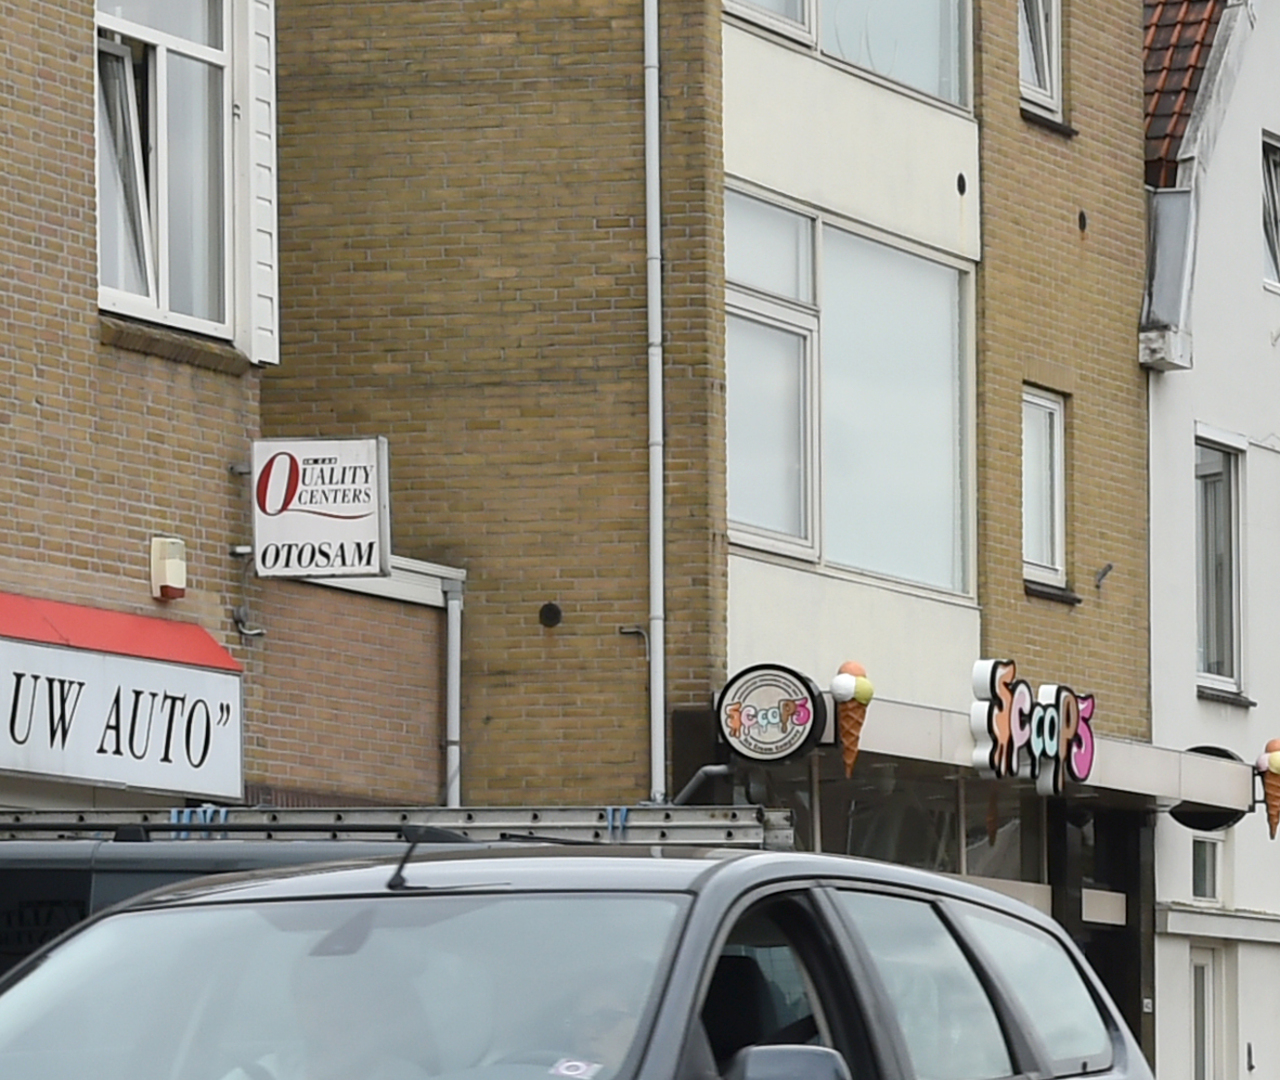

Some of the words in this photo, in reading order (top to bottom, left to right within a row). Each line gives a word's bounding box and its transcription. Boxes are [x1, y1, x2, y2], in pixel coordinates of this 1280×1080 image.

[298, 488, 371, 505] CENTERS
[261, 541, 376, 569] OTOSAM
[9, 671, 86, 751] UW
